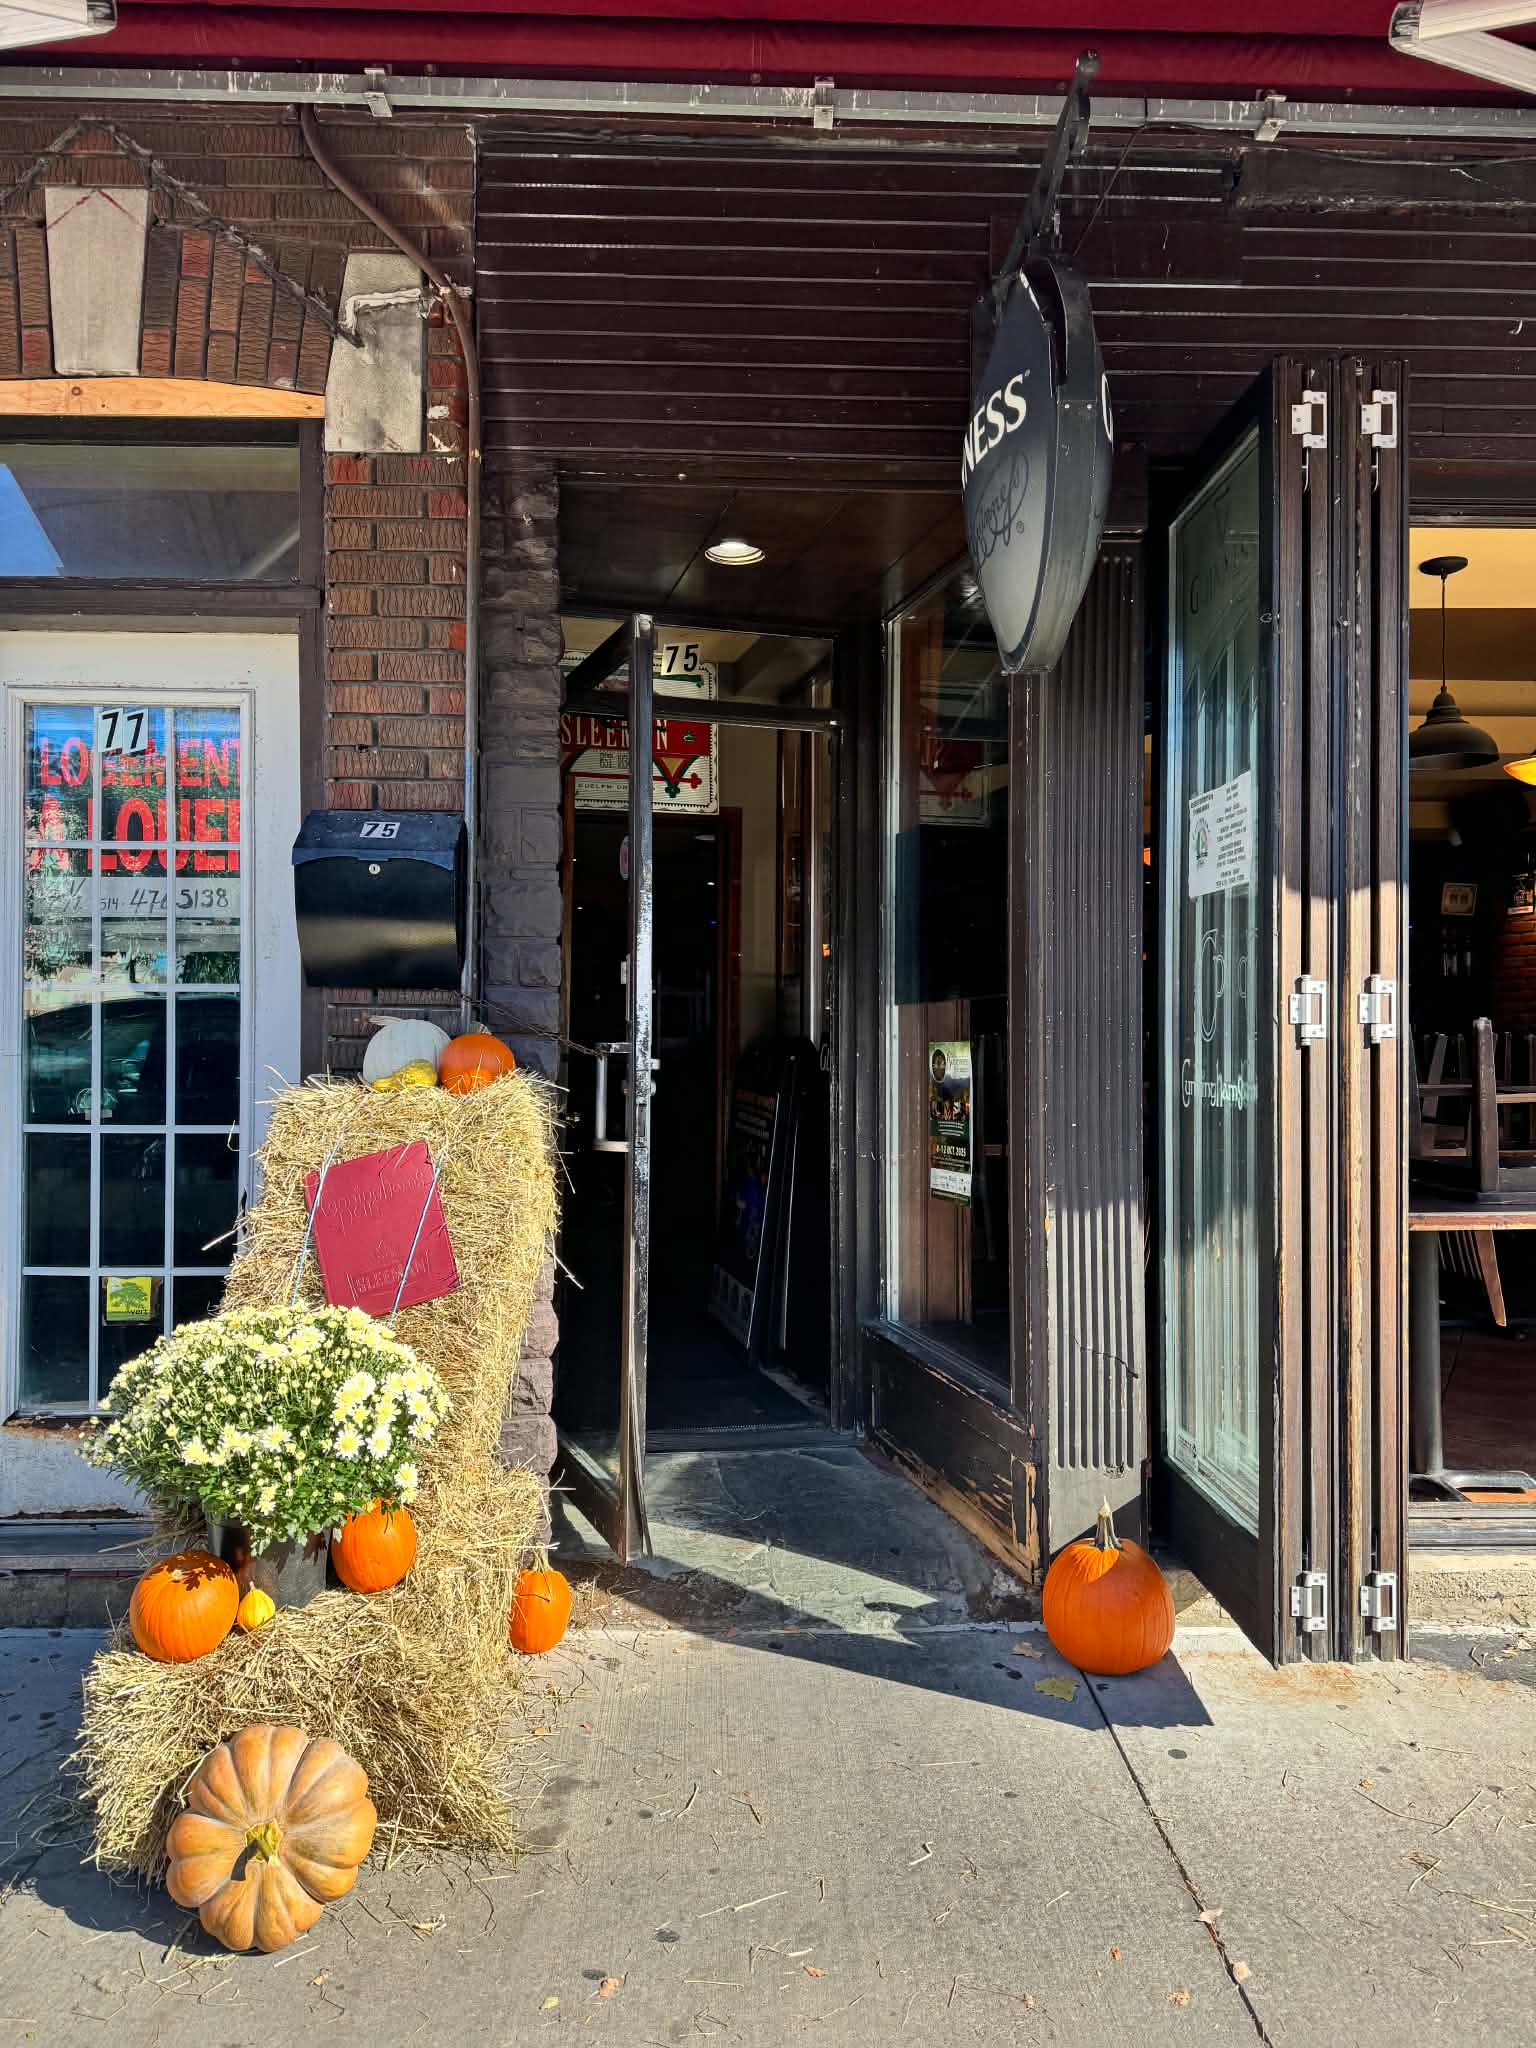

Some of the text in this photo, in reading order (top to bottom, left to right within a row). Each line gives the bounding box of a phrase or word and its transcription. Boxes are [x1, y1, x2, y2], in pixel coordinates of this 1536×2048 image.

[665, 643, 699, 673] 75
[102, 711, 144, 750] 77
[560, 712, 668, 750] SLEEN
[364, 823, 396, 838] 75
